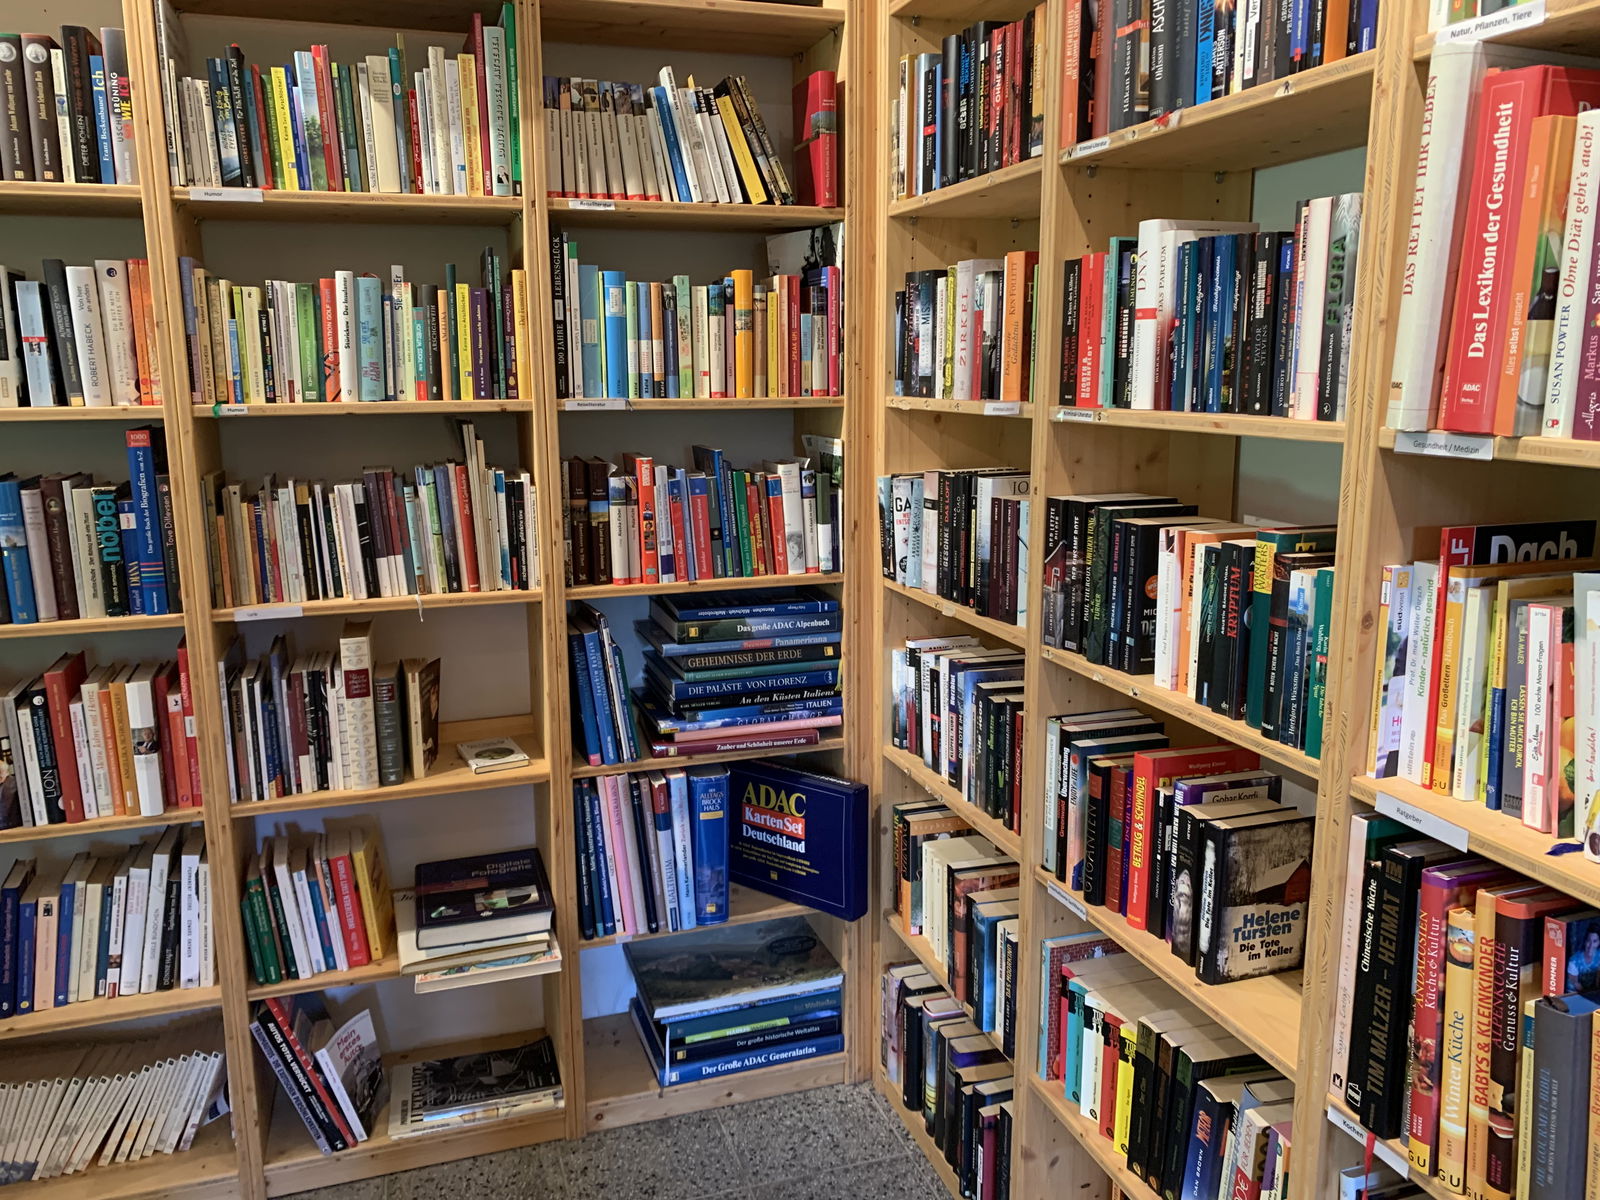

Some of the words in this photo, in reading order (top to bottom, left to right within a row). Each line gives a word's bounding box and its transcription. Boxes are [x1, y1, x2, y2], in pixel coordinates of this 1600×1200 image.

[1450, 24, 1473, 39] Natur,
[1474, 16, 1510, 32] Pflanzen,
[1512, 9, 1532, 22] Tiere
[1124, 40, 1132, 75] Nesser
[1216, 28, 1226, 76] PATTERSON
[92, 71, 104, 91] Ich
[111, 72, 121, 112] BRÜNING
[1122, 78, 1132, 112] Håkan
[97, 96, 108, 140] Beckenbauer
[698, 92, 707, 112] PIPER
[708, 94, 718, 115] PIPER
[1422, 74, 1438, 136] LEBEN
[115, 116, 124, 142] USCHI
[220, 130, 229, 150] HORST
[227, 130, 236, 150] EVERS
[1580, 124, 1594, 168] auch!
[102, 142, 110, 161] Franz
[1417, 142, 1430, 177] IHR
[1486, 100, 1514, 210] Gesundheit
[1572, 172, 1589, 214] geht's
[1482, 212, 1500, 244] der
[1567, 218, 1582, 252] Diät
[552, 236, 562, 296] LEBENSGLÜCK
[1010, 262, 1018, 296] FOLLETT
[1158, 245, 1167, 289] PARFUM
[1256, 260, 1267, 288] MUNROE
[1326, 234, 1347, 326] FLORA
[1402, 263, 1416, 296] DAS
[1472, 246, 1498, 319] Lexikon
[1562, 256, 1578, 298] Ohne
[1008, 298, 1016, 316] KEN
[1255, 289, 1266, 318] MISSION
[1510, 292, 1525, 326] gemacht
[84, 324, 94, 355] HABECK
[556, 323, 565, 350] JAHRE
[959, 288, 969, 366] ZIRKEL
[1467, 322, 1488, 358] Das
[1507, 328, 1520, 355] selbst
[1554, 304, 1572, 358] POWTER
[1254, 327, 1262, 364] TAYLOR
[1260, 324, 1268, 366] STEVENS
[1584, 335, 1600, 380] Markus
[90, 356, 98, 387] ROBERT
[1324, 363, 1332, 398] FRANZISKA
[1504, 356, 1517, 376] Alles
[1550, 362, 1564, 404] SUSAN
[1413, 439, 1448, 452] Gesundheit
[1454, 444, 1480, 454] Medizin
[92, 494, 120, 562] nobel
[754, 513, 763, 548] Transsib
[1490, 530, 1578, 565] Dach
[1257, 544, 1268, 590] WALTERS
[1226, 567, 1242, 638] KRYPTUM
[1424, 578, 1437, 614] gesund
[775, 636, 828, 647] Panamericana
[1420, 616, 1433, 658] natürlich
[688, 655, 752, 668] GEHEIMNISSE
[756, 652, 774, 662] DER
[777, 650, 802, 660] ERDE
[1536, 640, 1545, 685] Mama-Fragen
[688, 686, 704, 695] DIE
[706, 683, 742, 694] PALÄSTE
[746, 680, 768, 690] VON
[768, 676, 808, 687] FLORENZ
[740, 696, 752, 705] An
[754, 695, 770, 704] den
[772, 692, 802, 702] Küsten
[804, 689, 835, 699] Italiens
[1416, 666, 1428, 697] Kinder
[1518, 684, 1526, 711] LASSEN
[1534, 686, 1543, 704] echte
[806, 700, 832, 708] ITALIEN
[1510, 698, 1519, 710] ICH
[1510, 712, 1518, 724] BIN
[1518, 712, 1526, 723] SIE
[1534, 704, 1542, 717] 100
[1508, 725, 1518, 752] MUTTER
[1516, 724, 1526, 742] MICH
[1060, 746, 1070, 798] Überwachung
[1514, 742, 1524, 768] DURCH,
[43, 770, 56, 798] LION
[743, 782, 806, 817] ADAC
[1134, 776, 1146, 821] SCHWINDEL
[610, 784, 621, 826] AUSTRALIEN
[745, 806, 803, 836] KartenSet
[1396, 808, 1423, 825] Ratgeber
[742, 824, 806, 853] Deutschland
[1133, 822, 1143, 830] &
[486, 858, 531, 870] Digitale
[1083, 804, 1097, 892] GIGANTEN
[1132, 832, 1143, 868] BETRUG
[471, 864, 533, 878] Fotografie
[665, 858, 676, 904] BALTIKUM
[1366, 878, 1378, 910] Küche
[1232, 922, 1292, 942] Tursten
[1243, 908, 1301, 929] Helene
[1378, 888, 1400, 965] HEIMAT
[1239, 943, 1256, 953] Die
[1260, 938, 1281, 949] Tote
[1248, 951, 1261, 962] im
[1264, 946, 1294, 958] Keller
[1360, 913, 1376, 972] Chinesische
[1428, 916, 1441, 958] Kultur
[1416, 909, 1428, 1008] ANDALUSIEN
[1427, 960, 1438, 969] &
[1506, 946, 1520, 990] Kultur
[1424, 971, 1438, 1009] Küche
[1476, 936, 1494, 1037] KLEINKINDER
[1490, 942, 1506, 1048] ALPENKÜCHE
[1506, 992, 1517, 1003] &
[747, 1036, 764, 1045] große
[764, 1030, 794, 1042] historische
[794, 1026, 820, 1036] Weltatlas
[1368, 984, 1392, 1061] MÄLZER
[1502, 1004, 1517, 1051] Genuss
[268, 1023, 282, 1042] AUTOS
[279, 1042, 294, 1062] TOTAL
[288, 1061, 312, 1094] VERRÜCKT
[702, 1066, 718, 1076] Der
[718, 1060, 742, 1073] Große
[744, 1054, 768, 1067] ADAC
[770, 1046, 817, 1062] Generalatlas
[1477, 1042, 1490, 1053] &
[1366, 1062, 1385, 1096] TIM
[1474, 1055, 1490, 1106] BABYS
[1195, 1110, 1212, 1146] METEOR
[1342, 1120, 1365, 1140] Kochen
[1196, 1148, 1204, 1178] BROWN
[1438, 1168, 1462, 1188] GU
